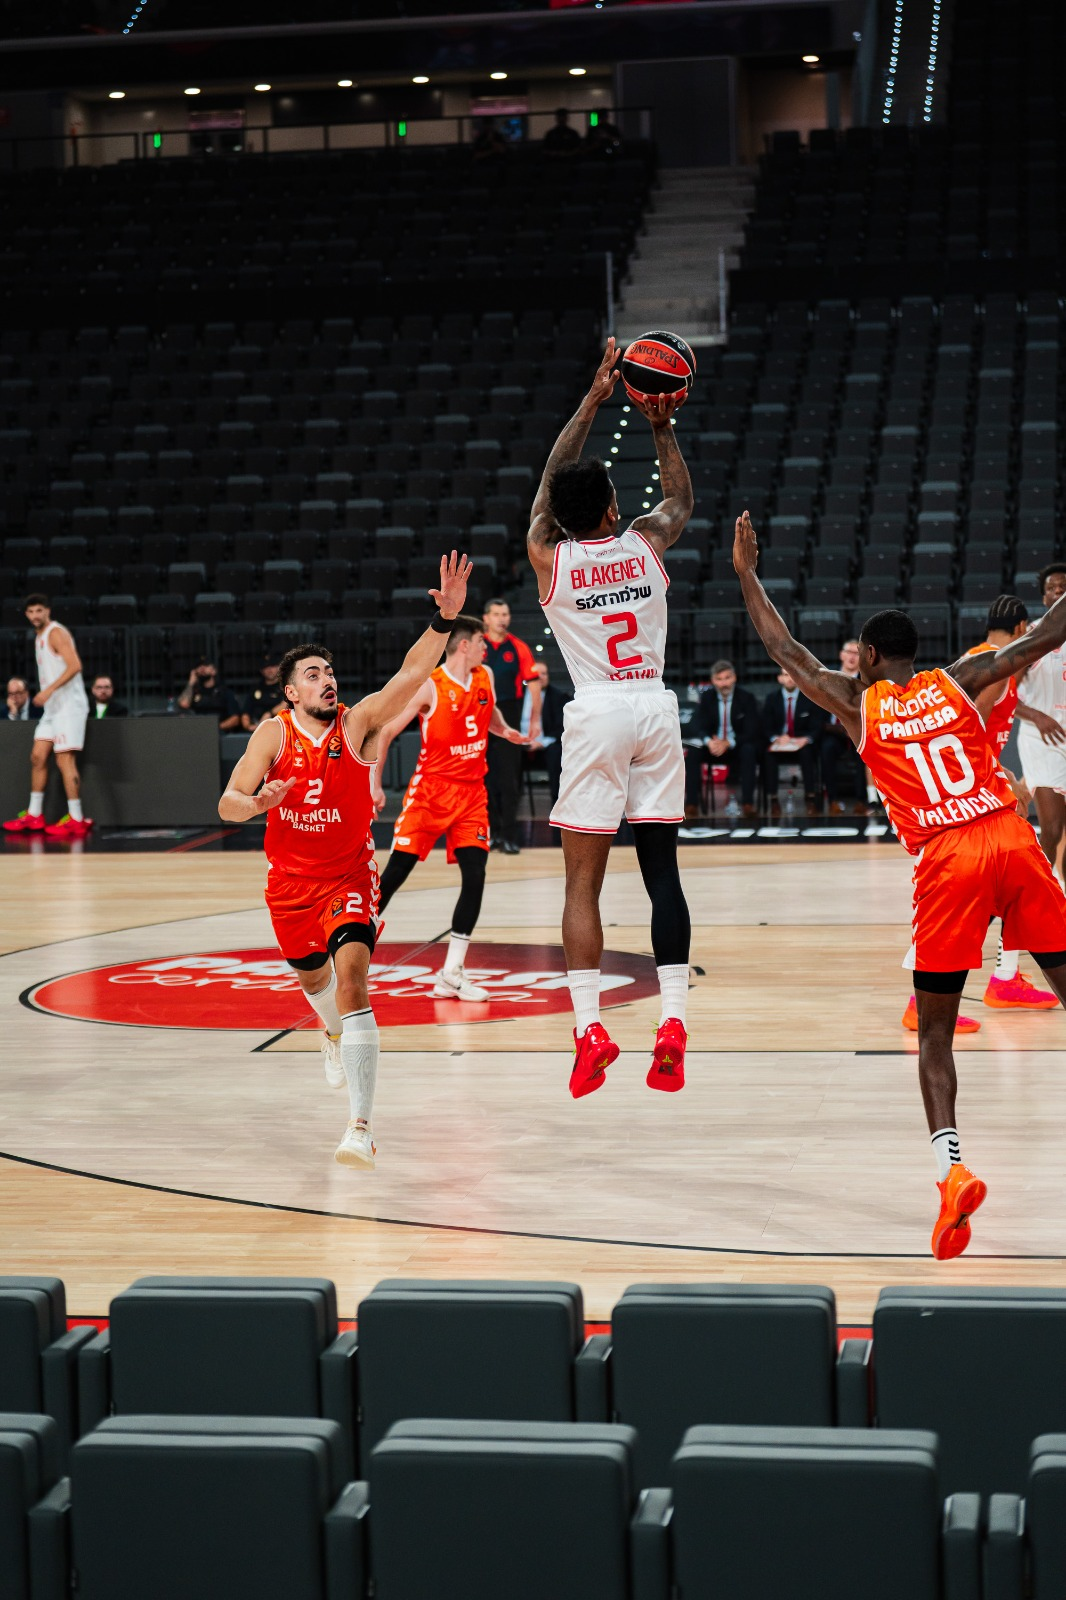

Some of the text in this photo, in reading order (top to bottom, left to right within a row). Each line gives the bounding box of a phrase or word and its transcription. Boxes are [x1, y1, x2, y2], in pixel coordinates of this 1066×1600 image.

[630, 343, 680, 369] SPALDING
[570, 555, 646, 590] BLAKENEY
[601, 611, 643, 669] 2
[879, 683, 946, 718] MOORE
[465, 715, 479, 738] 5
[879, 705, 958, 740] PAMESA
[904, 733, 975, 805] 10
[303, 777, 324, 805] 2
[278, 806, 342, 823] VALENCIA
[912, 787, 1004, 828] VALENCIA
[292, 821, 326, 833] BASKET
[345, 892, 363, 914] 2
